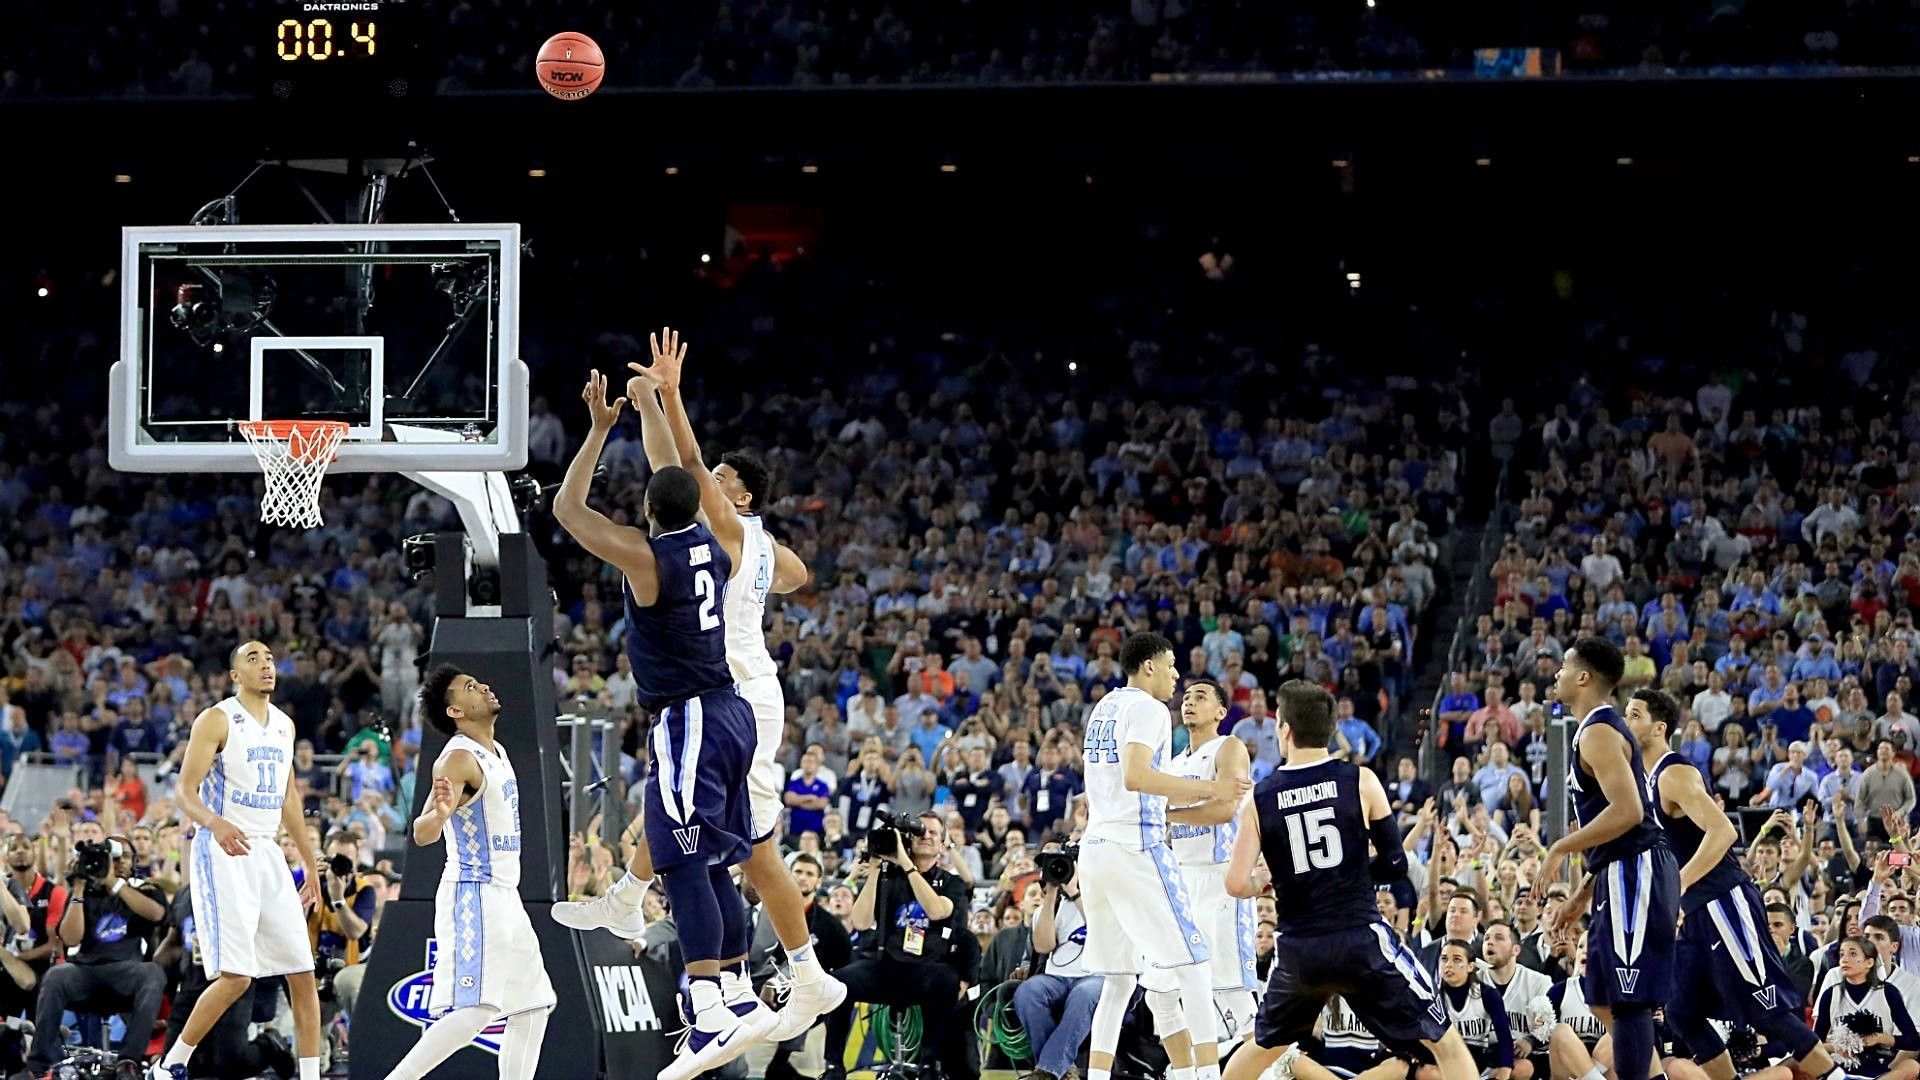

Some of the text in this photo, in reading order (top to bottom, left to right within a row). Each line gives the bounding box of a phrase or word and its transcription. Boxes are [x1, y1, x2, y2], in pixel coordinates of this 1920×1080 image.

[303, 3, 379, 11] DAKTRONICS
[277, 18, 376, 60] 00.4
[551, 70, 584, 82] NCAA
[694, 569, 720, 631] 2
[247, 746, 284, 763] NORTH
[1084, 719, 1119, 764] 44
[256, 762, 277, 793] 11
[1277, 780, 1339, 810] ARCIDIACONO
[672, 825, 700, 855] V
[1284, 806, 1344, 875] 15
[1615, 967, 1640, 994] V
[1427, 993, 1447, 1025] V
[1752, 984, 1778, 1010] V
